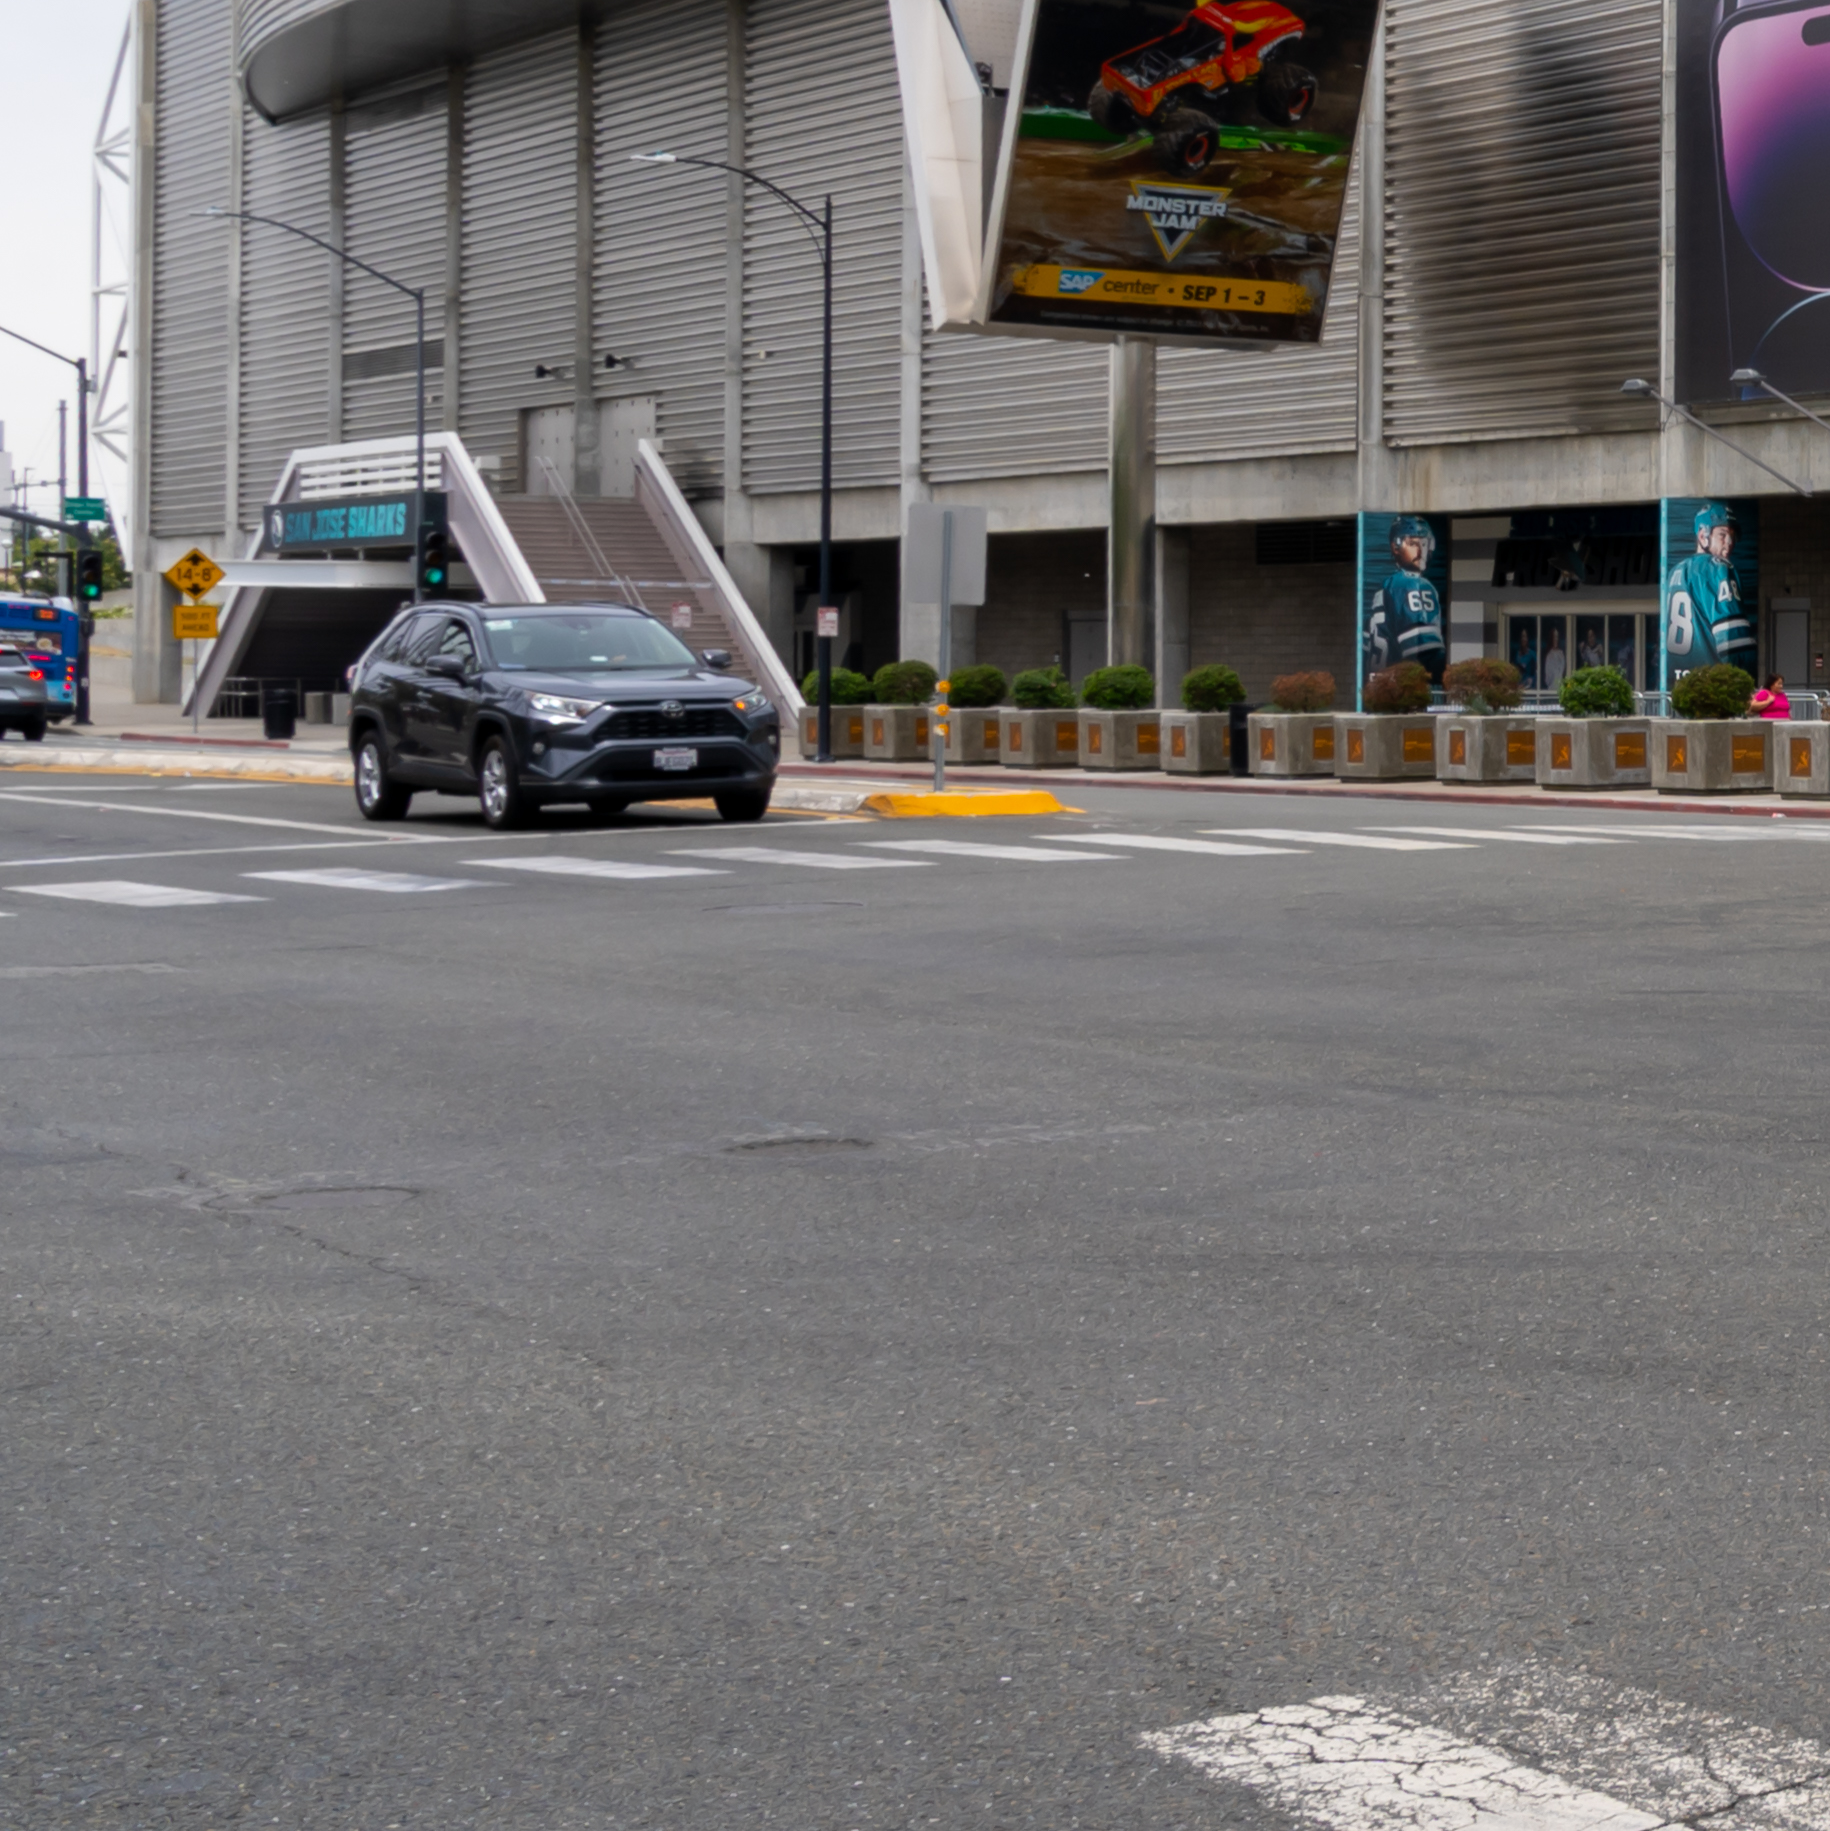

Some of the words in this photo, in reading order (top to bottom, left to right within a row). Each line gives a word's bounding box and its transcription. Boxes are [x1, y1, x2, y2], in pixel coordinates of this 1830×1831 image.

[1127, 195, 1227, 216] MONSTER
[1152, 213, 1197, 230] JAM
[1059, 273, 1094, 291] SAP
[1103, 277, 1158, 296] center
[1183, 285, 1216, 302] SEP
[1223, 288, 1230, 303] 1
[1255, 290, 1265, 306] 3
[285, 512, 312, 543] SAN
[312, 508, 346, 541] JOSE
[348, 502, 406, 537] SHARKS
[1407, 590, 1434, 613] 65
